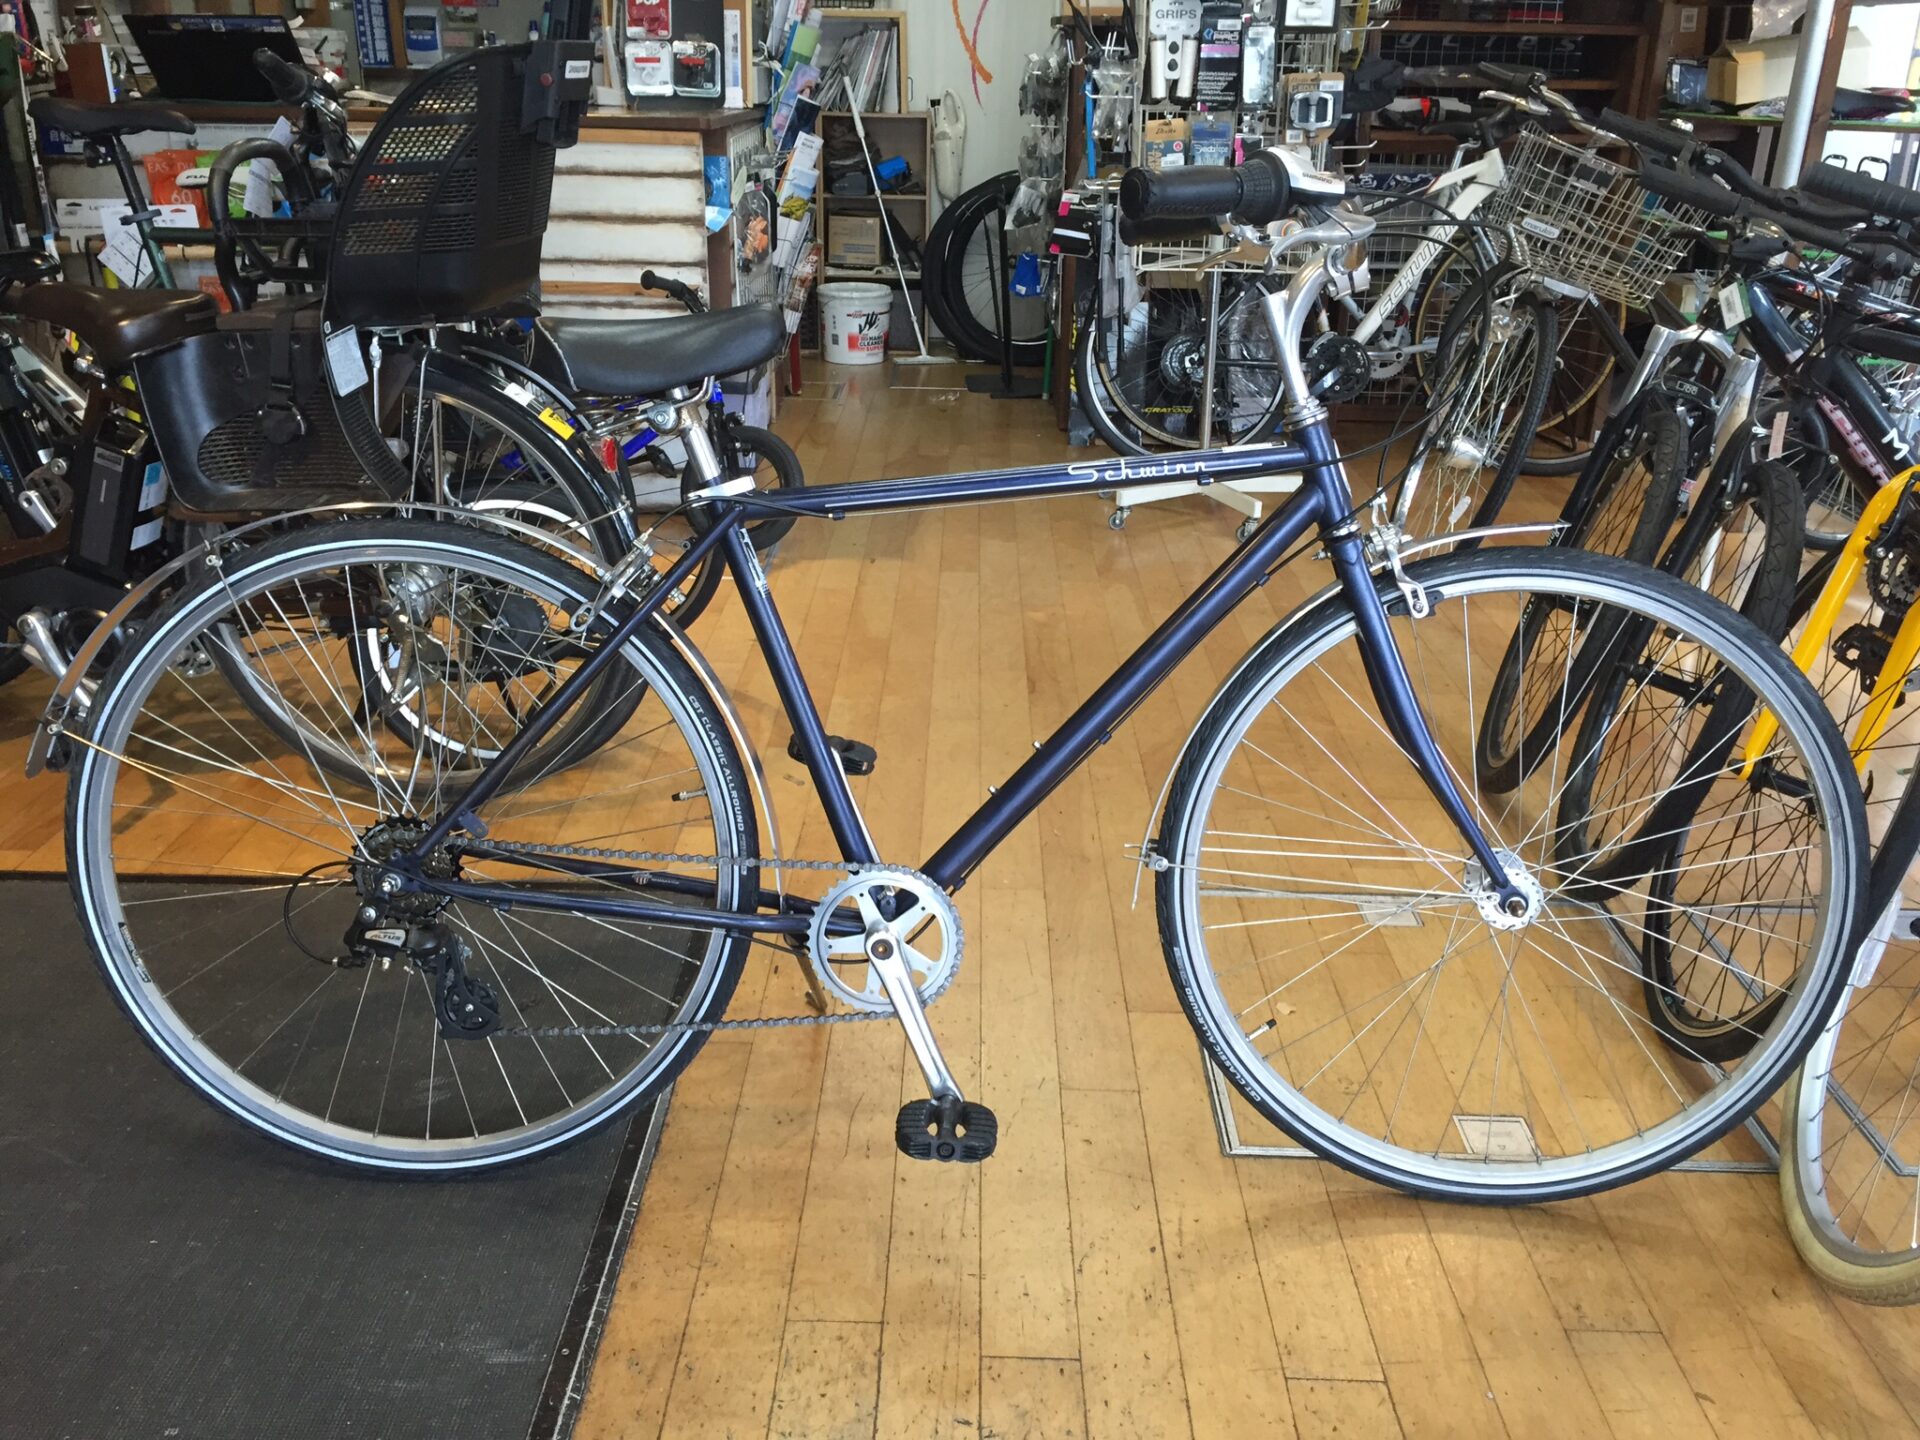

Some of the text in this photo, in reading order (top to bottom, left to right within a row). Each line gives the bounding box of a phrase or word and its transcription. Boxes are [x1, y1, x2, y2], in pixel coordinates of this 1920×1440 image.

[1155, 9, 1197, 19] GRIPS
[1067, 458, 1215, 483] Schwinn
[688, 694, 705, 715] CST
[701, 716, 728, 766] CLASSIC
[722, 766, 746, 832] ALLROUND
[1185, 986, 1217, 1044] ALLROUND
[1213, 1044, 1246, 1086] CLASSIC
